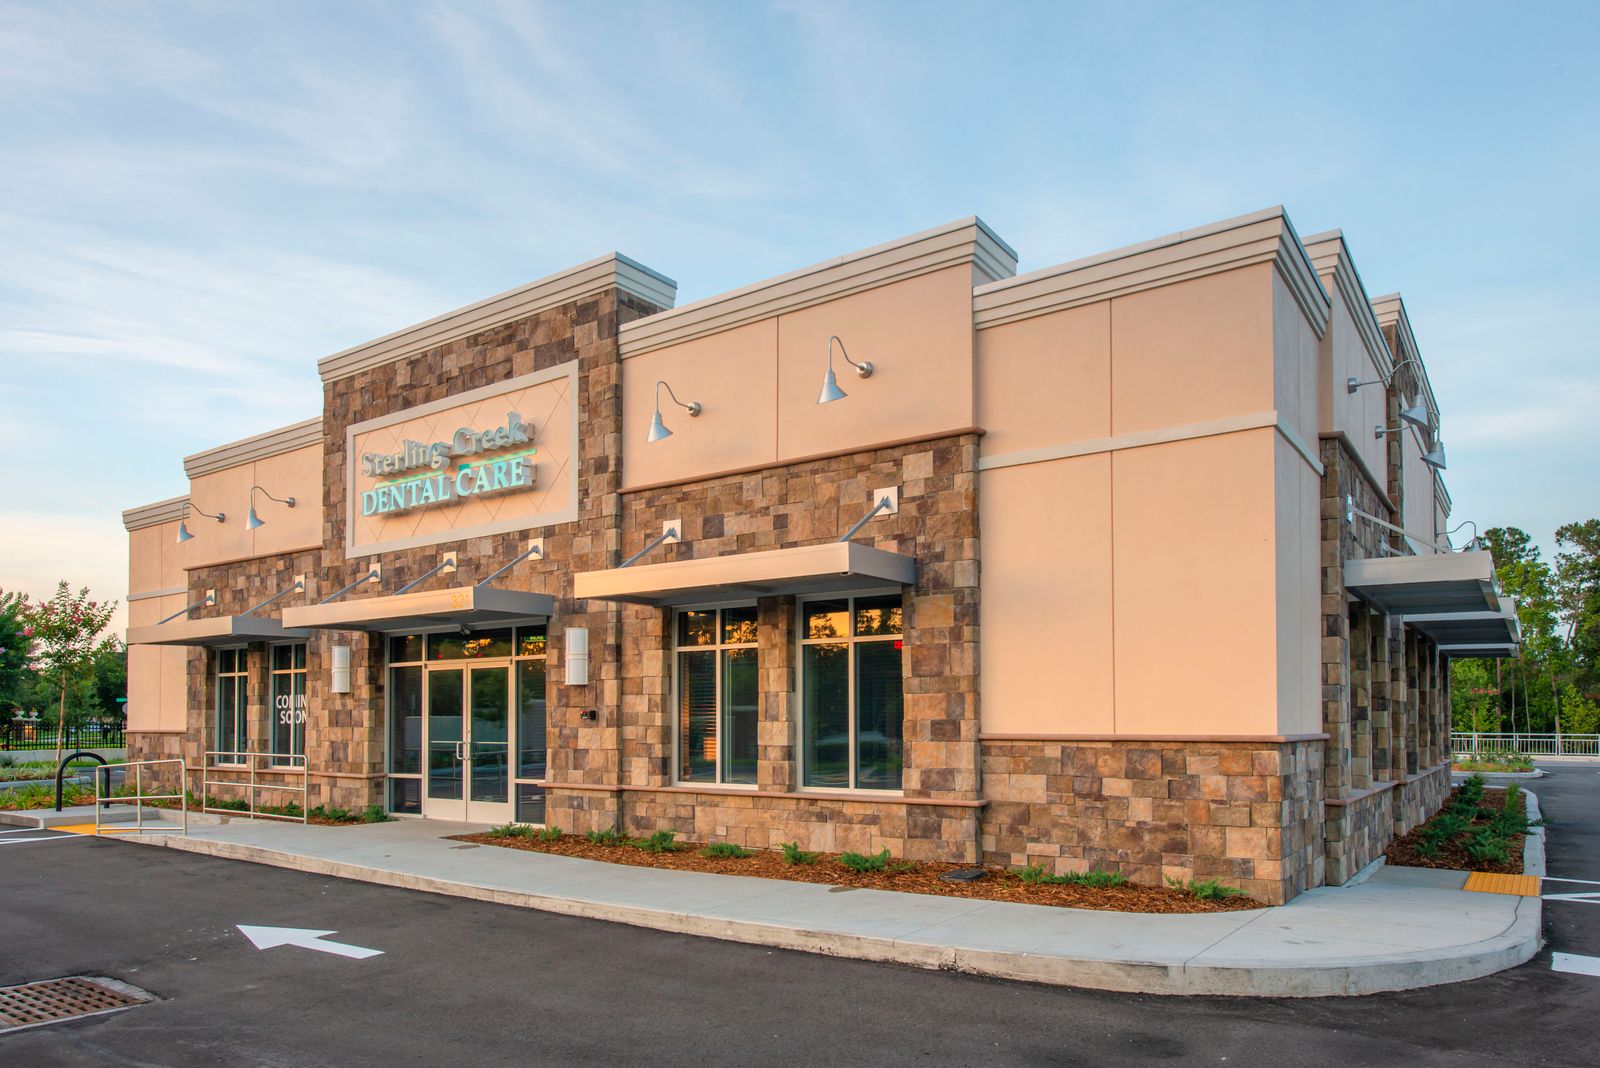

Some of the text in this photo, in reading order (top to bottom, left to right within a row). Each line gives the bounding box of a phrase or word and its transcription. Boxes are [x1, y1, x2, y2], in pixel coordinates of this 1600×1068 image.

[362, 411, 528, 477] Sterling Creek
[362, 457, 529, 516] DENTAL CARE
[451, 592, 469, 609] 321
